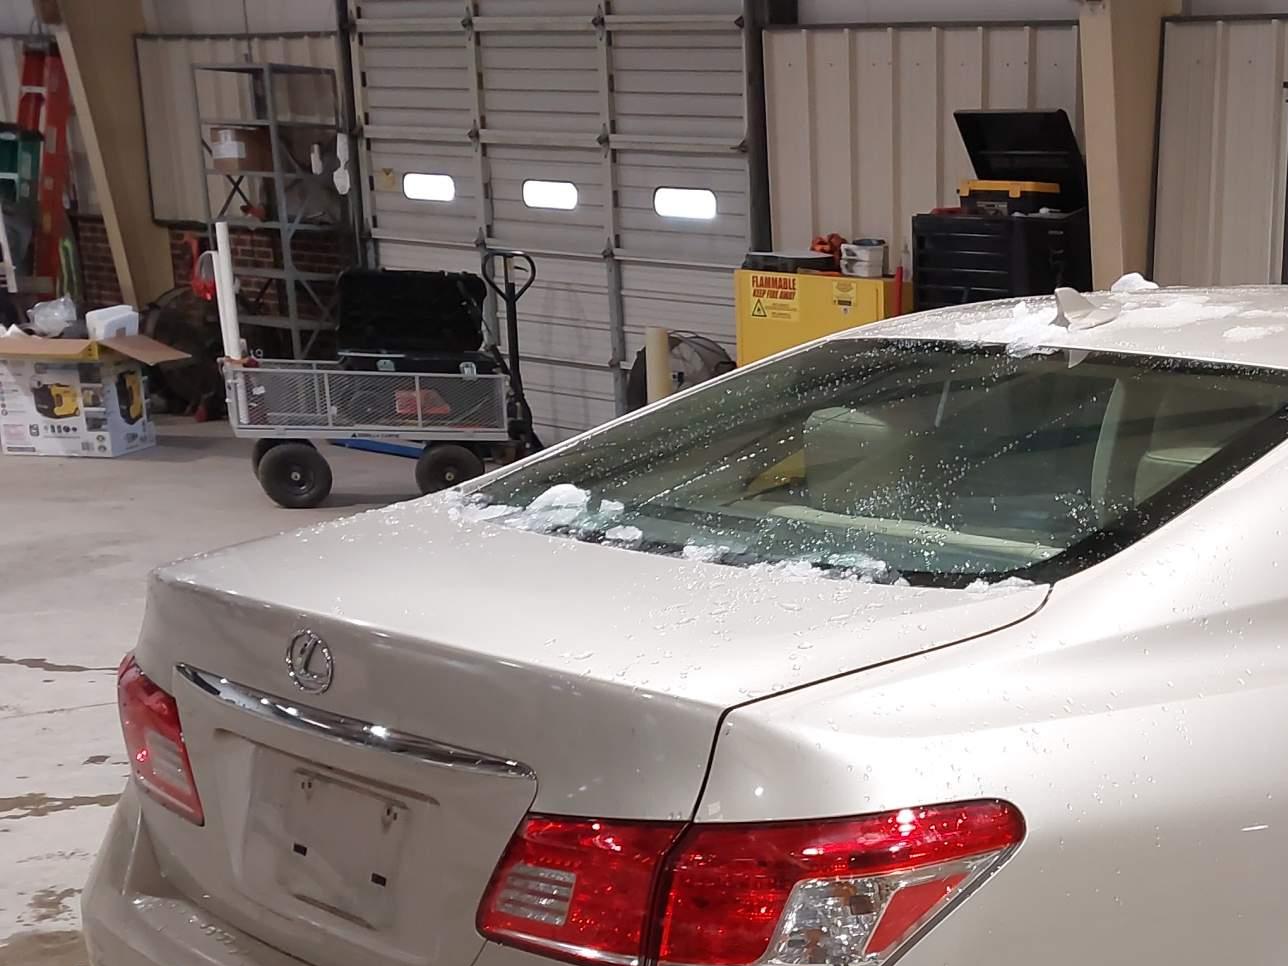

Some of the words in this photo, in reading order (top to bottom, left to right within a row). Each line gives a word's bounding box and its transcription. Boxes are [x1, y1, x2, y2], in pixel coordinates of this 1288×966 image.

[752, 275, 797, 290] FLAMMABLE
[752, 288, 767, 298] KEEP
[766, 290, 779, 299] FIRE
